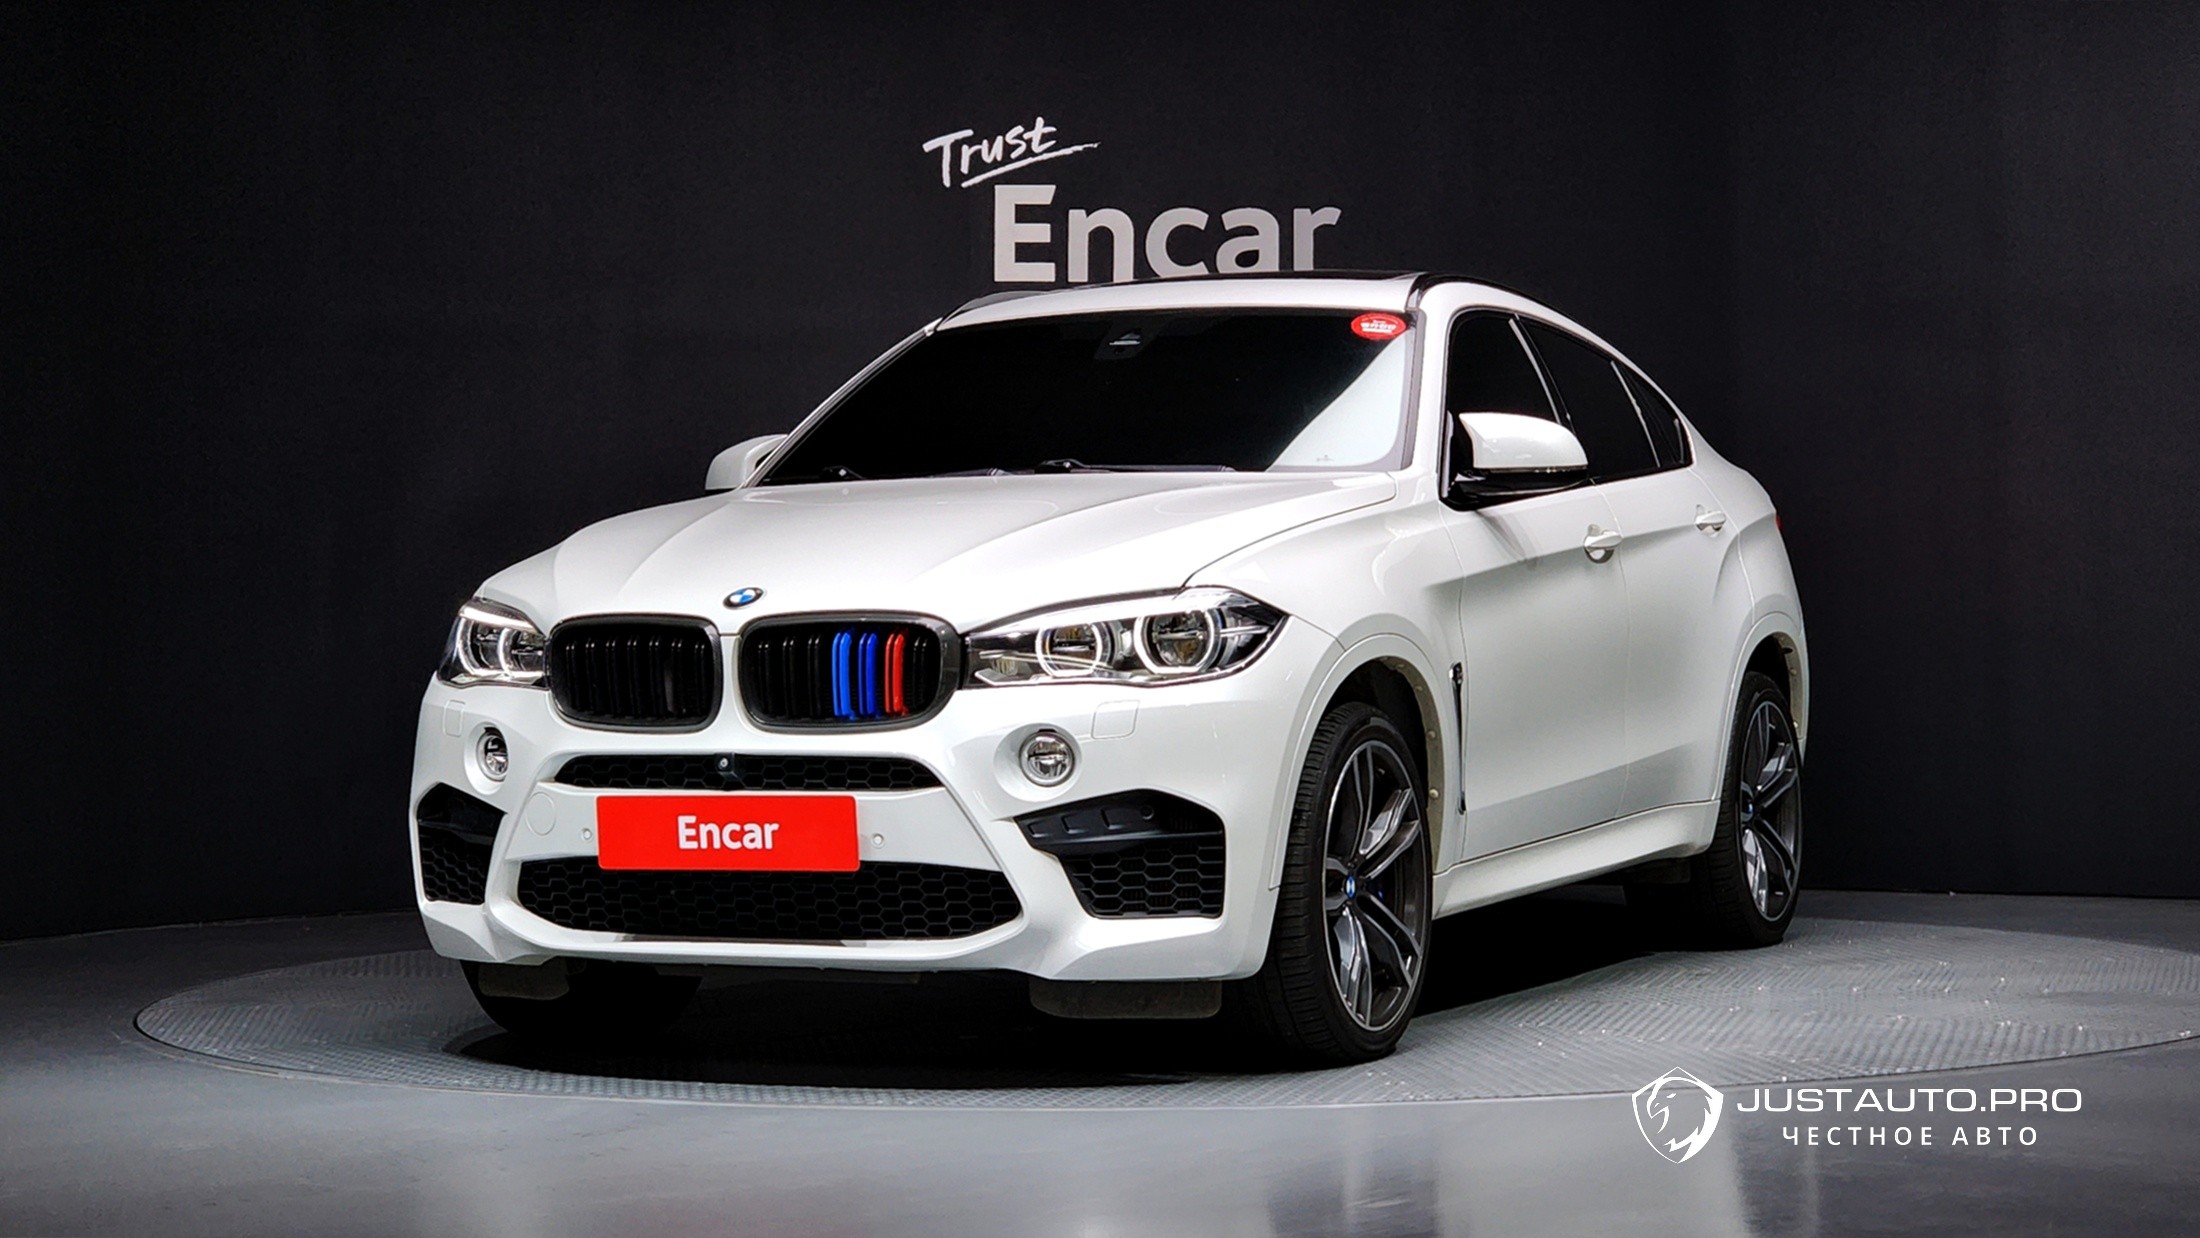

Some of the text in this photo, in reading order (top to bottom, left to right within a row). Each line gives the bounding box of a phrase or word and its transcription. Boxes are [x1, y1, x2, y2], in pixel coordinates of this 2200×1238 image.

[922, 117, 1059, 187] Trust
[994, 185, 1342, 283] Encar
[677, 815, 779, 849] Encar
